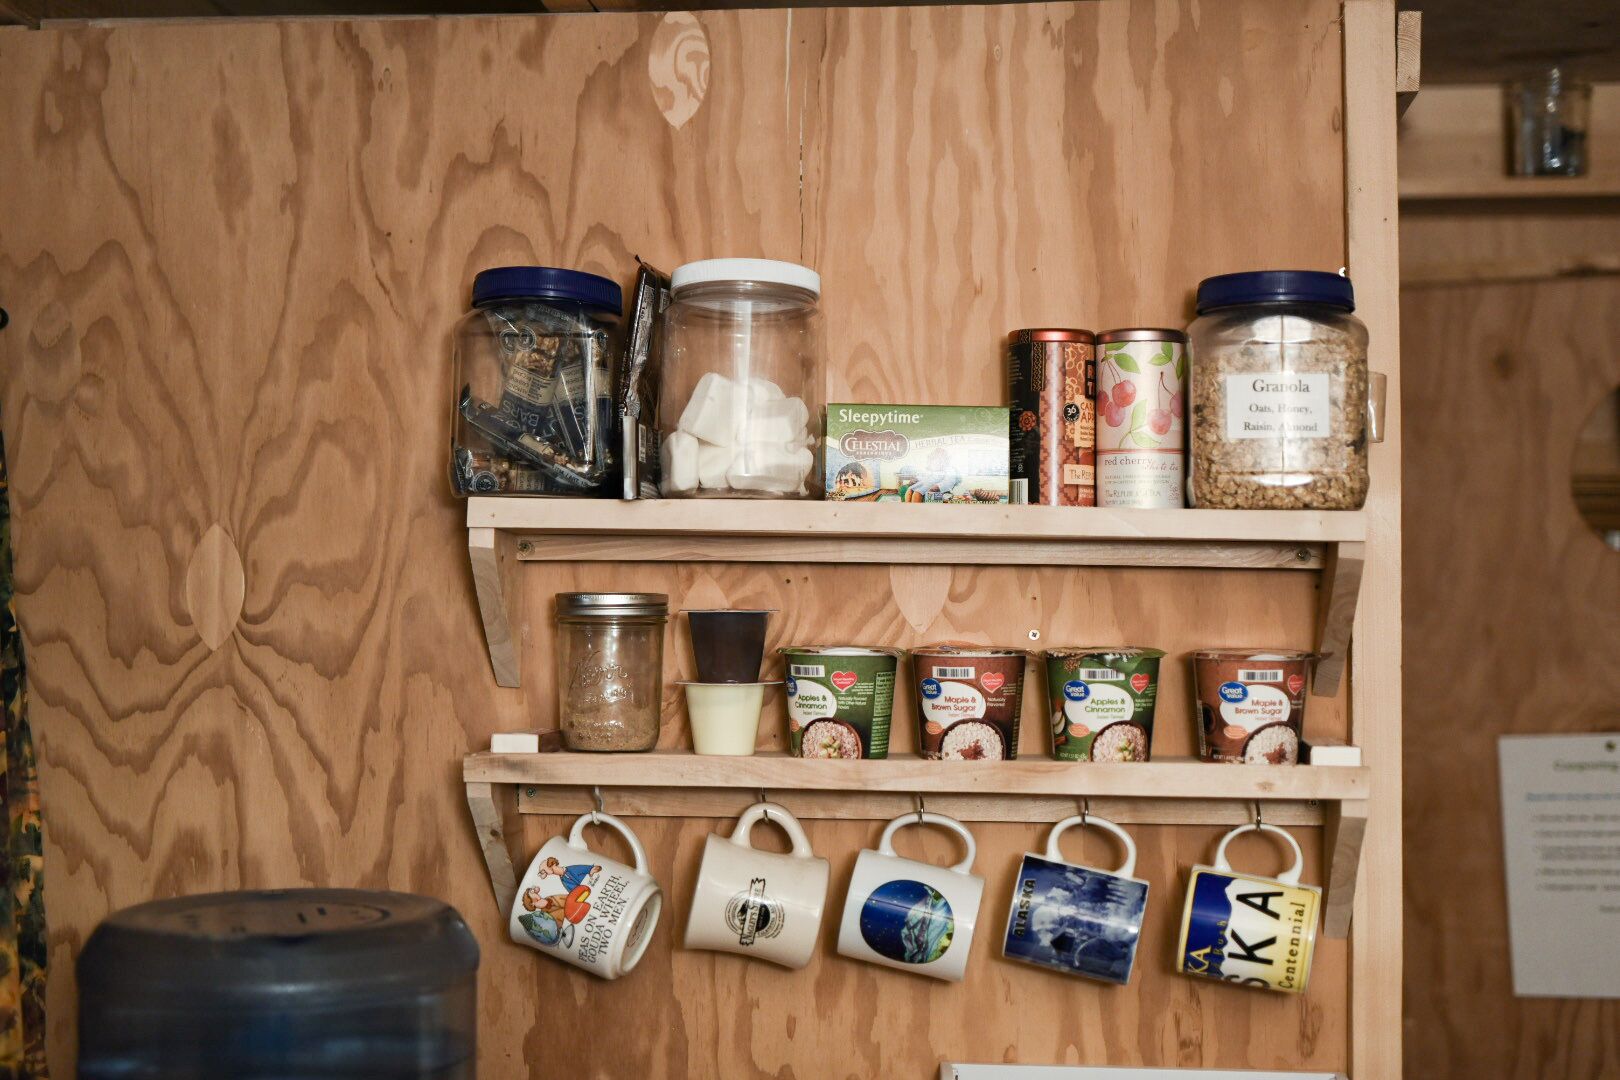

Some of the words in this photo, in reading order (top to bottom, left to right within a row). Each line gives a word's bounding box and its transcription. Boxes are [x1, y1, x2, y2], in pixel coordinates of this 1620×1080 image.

[1252, 379, 1310, 393] Granola
[1066, 406, 1077, 416] 36
[1249, 403, 1275, 415] Oats,
[1278, 403, 1313, 415] Honey,
[839, 409, 920, 426] Sleepytime
[1243, 421, 1275, 432] Raisin,
[1278, 421, 1318, 432] Almond
[844, 437, 900, 452] CELESTIAL
[1104, 457, 1117, 466] red
[797, 694, 820, 702] Apples
[944, 696, 970, 704] Maple
[795, 702, 827, 710] Cinnamon
[954, 704, 976, 712] Sugar
[1013, 878, 1036, 938] ALASKA
[584, 916, 598, 933] ON
[587, 923, 605, 963] GOUDA
[598, 929, 613, 956] TWO
[1278, 901, 1306, 989] Centennial
